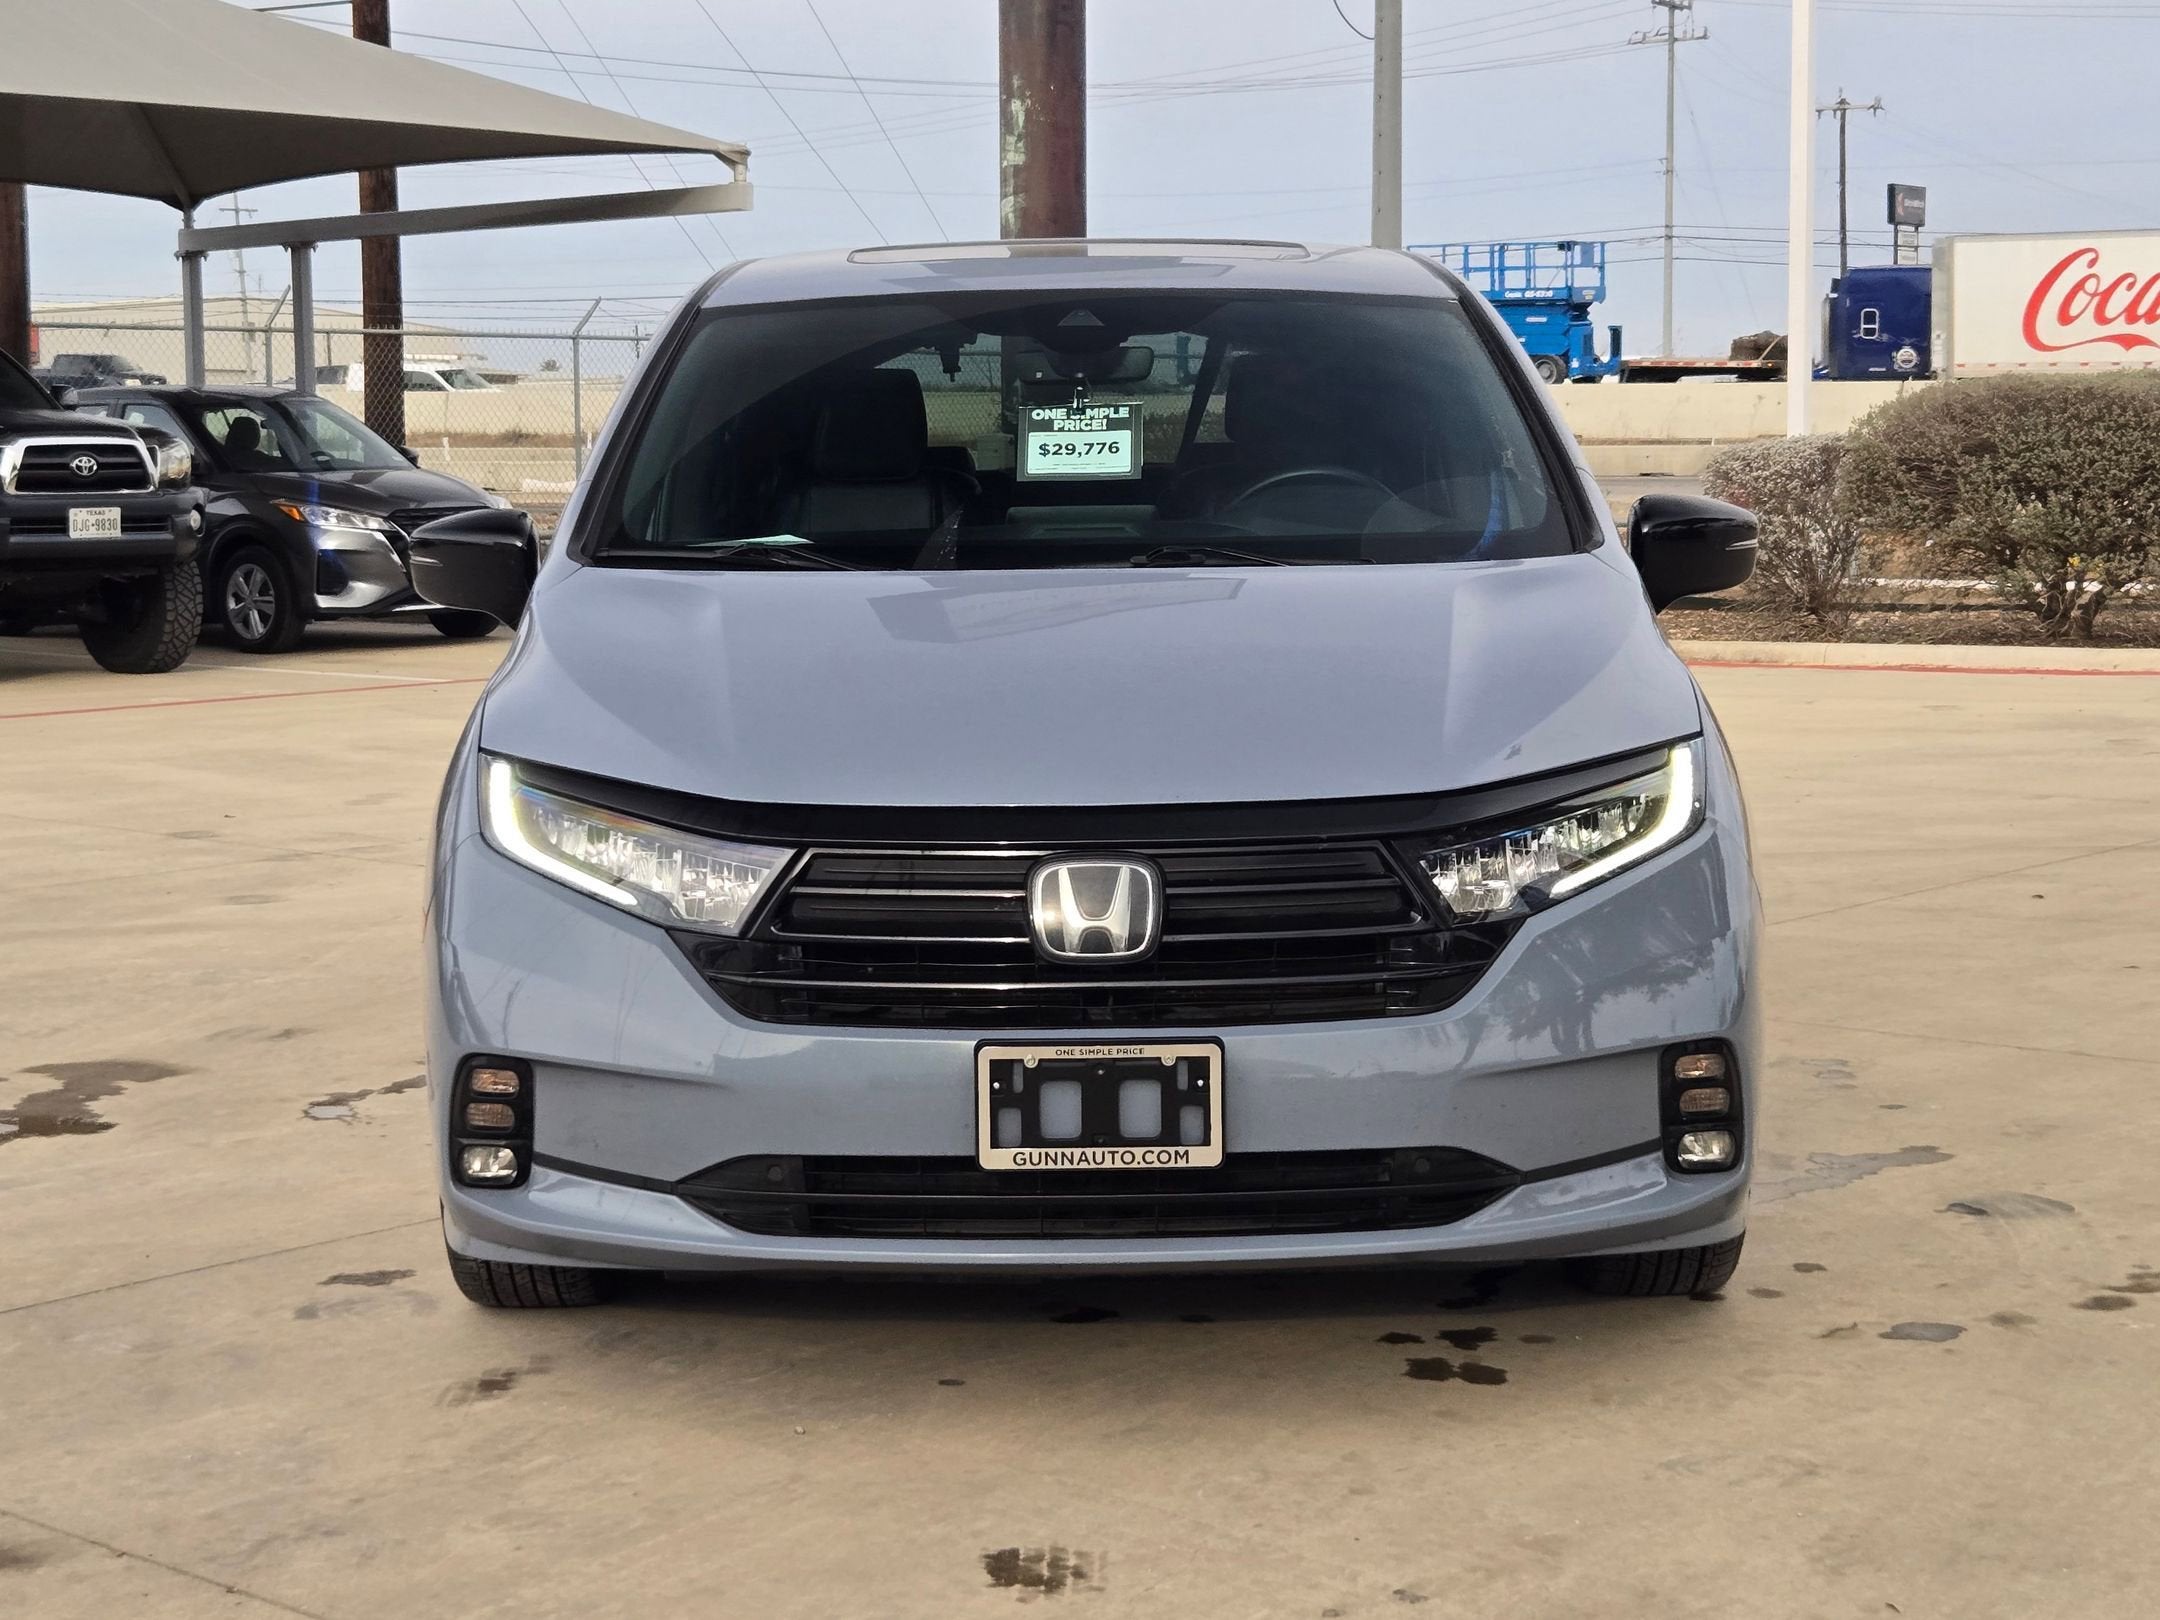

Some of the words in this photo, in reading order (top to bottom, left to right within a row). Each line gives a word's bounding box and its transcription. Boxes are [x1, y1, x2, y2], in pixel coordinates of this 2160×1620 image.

[1031, 408, 1067, 419] ONE
[1053, 419, 1107, 430] PRICE!
[1039, 441, 1120, 457] $29,776
[1055, 1048, 1076, 1056] ONE
[1079, 1048, 1113, 1056] SIMPLE
[1013, 1150, 1189, 1165] GUNNAUTO.COM
